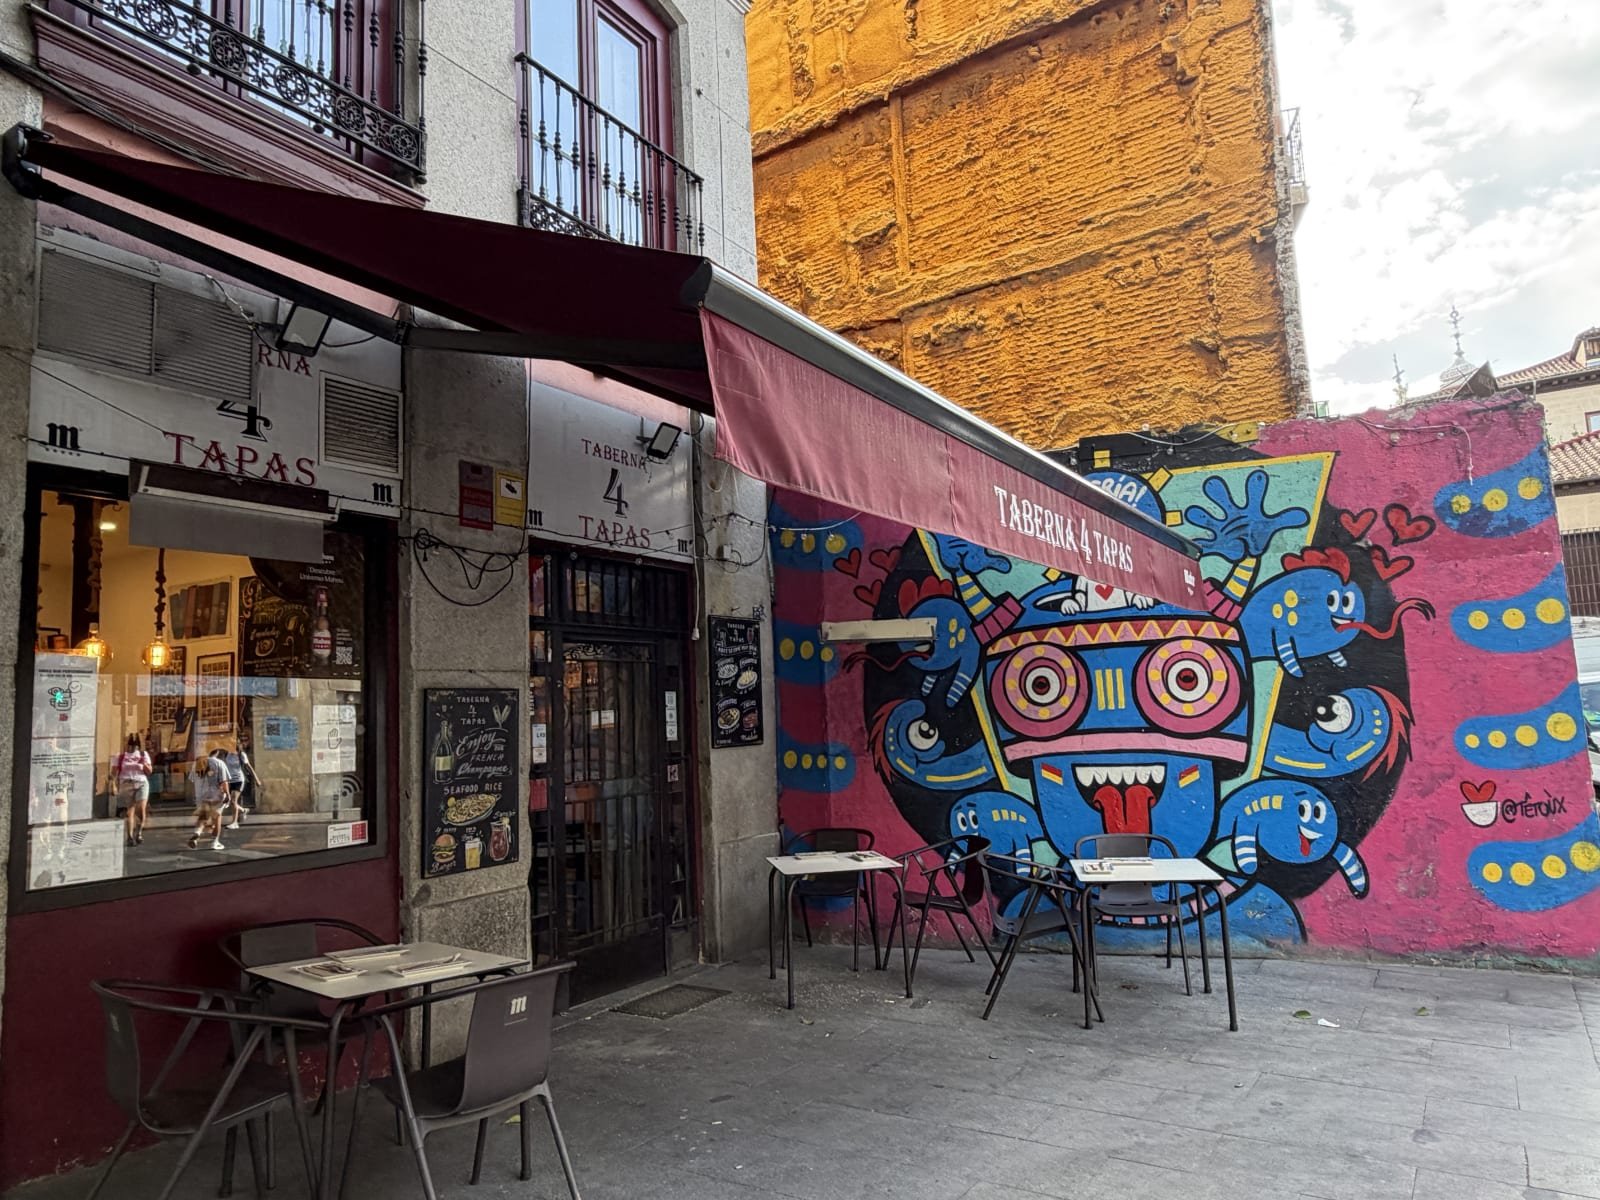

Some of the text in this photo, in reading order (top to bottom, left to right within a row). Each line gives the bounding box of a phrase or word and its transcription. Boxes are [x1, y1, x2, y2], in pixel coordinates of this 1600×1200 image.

[163, 431, 317, 487] TAPAS
[581, 438, 648, 474] TABERNA
[603, 467, 629, 519] 4
[578, 515, 650, 548] TAPAS
[993, 485, 1134, 574] TABERNA 4 TAPAS
[456, 730, 506, 757] Enjoy
[471, 753, 504, 762] FRENCH
[443, 782, 503, 795] SEAFOOD RICE
